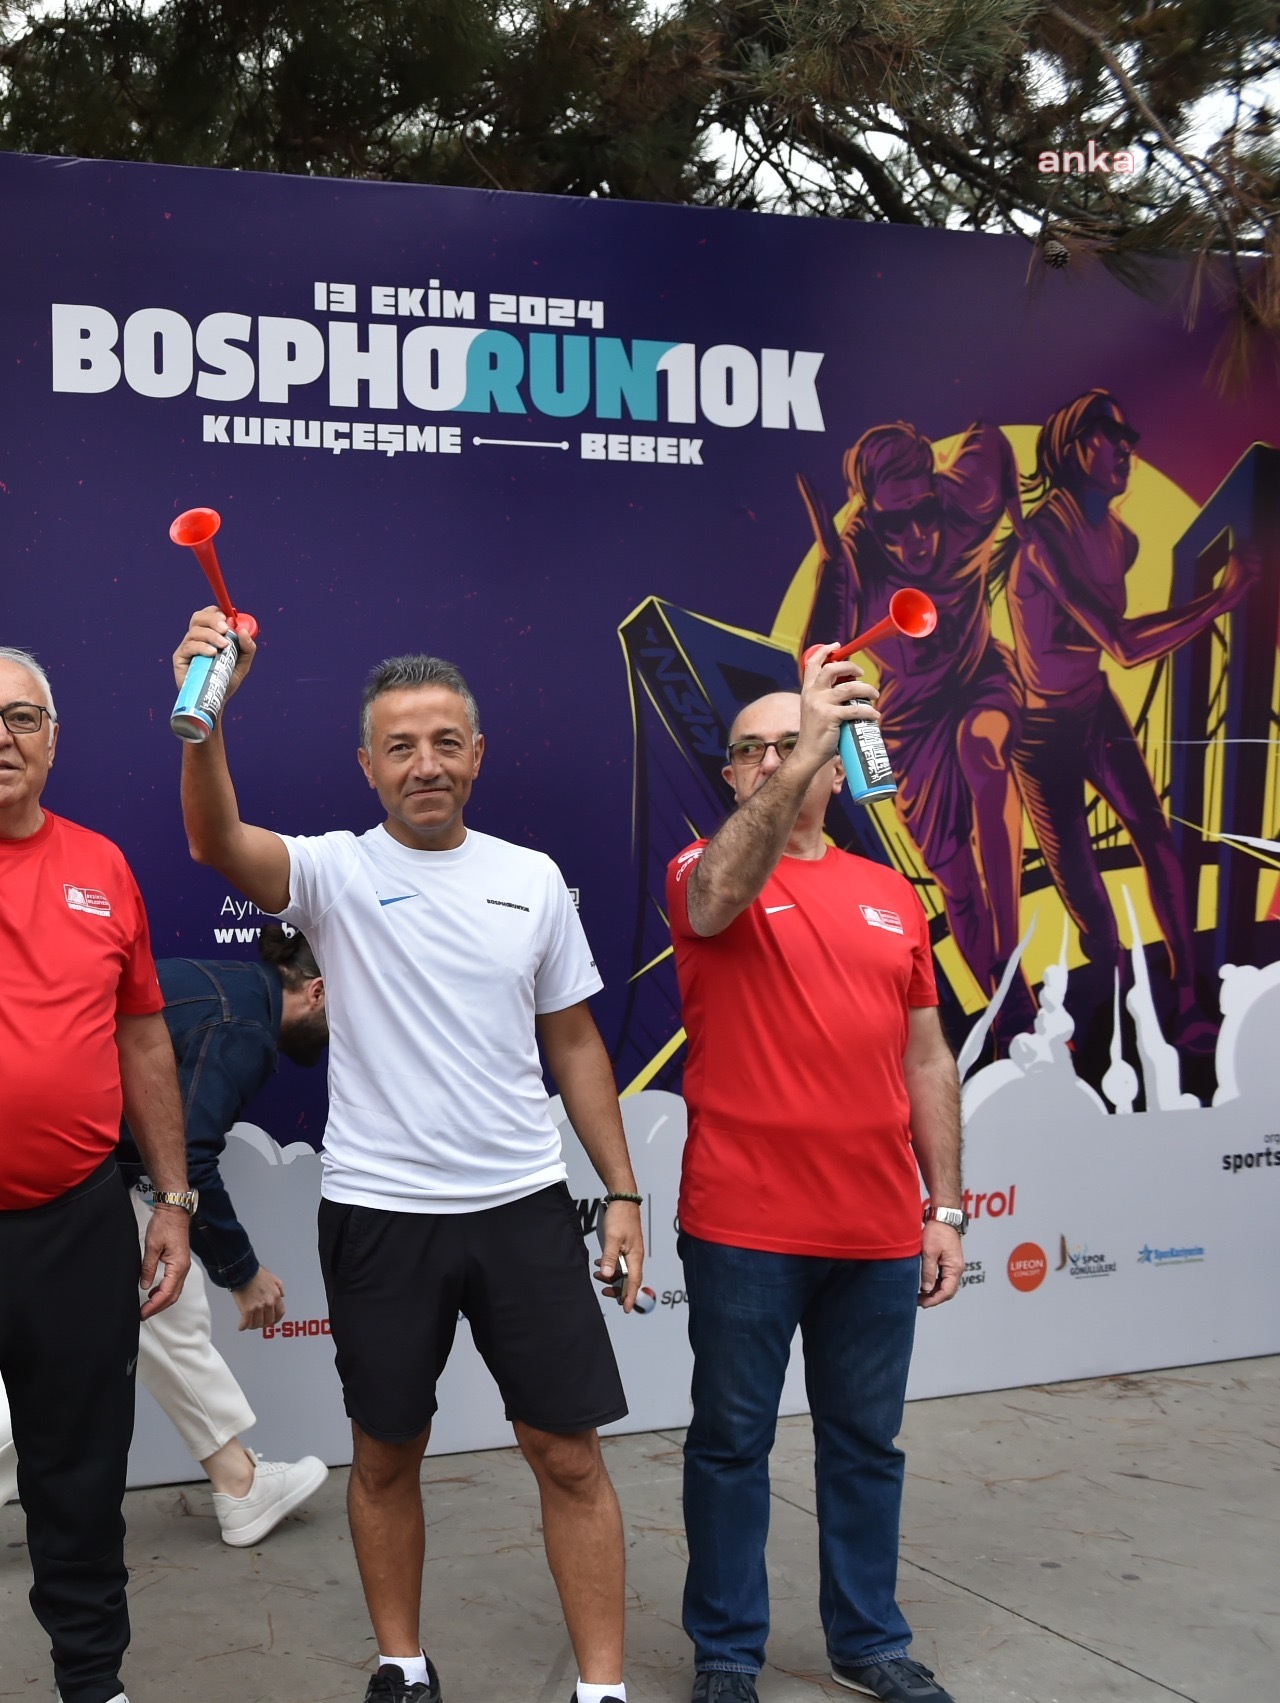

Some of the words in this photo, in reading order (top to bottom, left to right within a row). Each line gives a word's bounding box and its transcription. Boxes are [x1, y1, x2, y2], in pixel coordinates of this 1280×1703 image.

[314, 281, 357, 313] 13
[371, 278, 476, 320] EKİM
[489, 293, 605, 329] 2024
[202, 415, 463, 457] KURUÇEŞME
[580, 432, 705, 465] BEBEK
[1010, 1259, 1044, 1271] LIFEON
[1082, 1254, 1105, 1264] SPOR
[262, 1318, 332, 1339] G-SHOC
